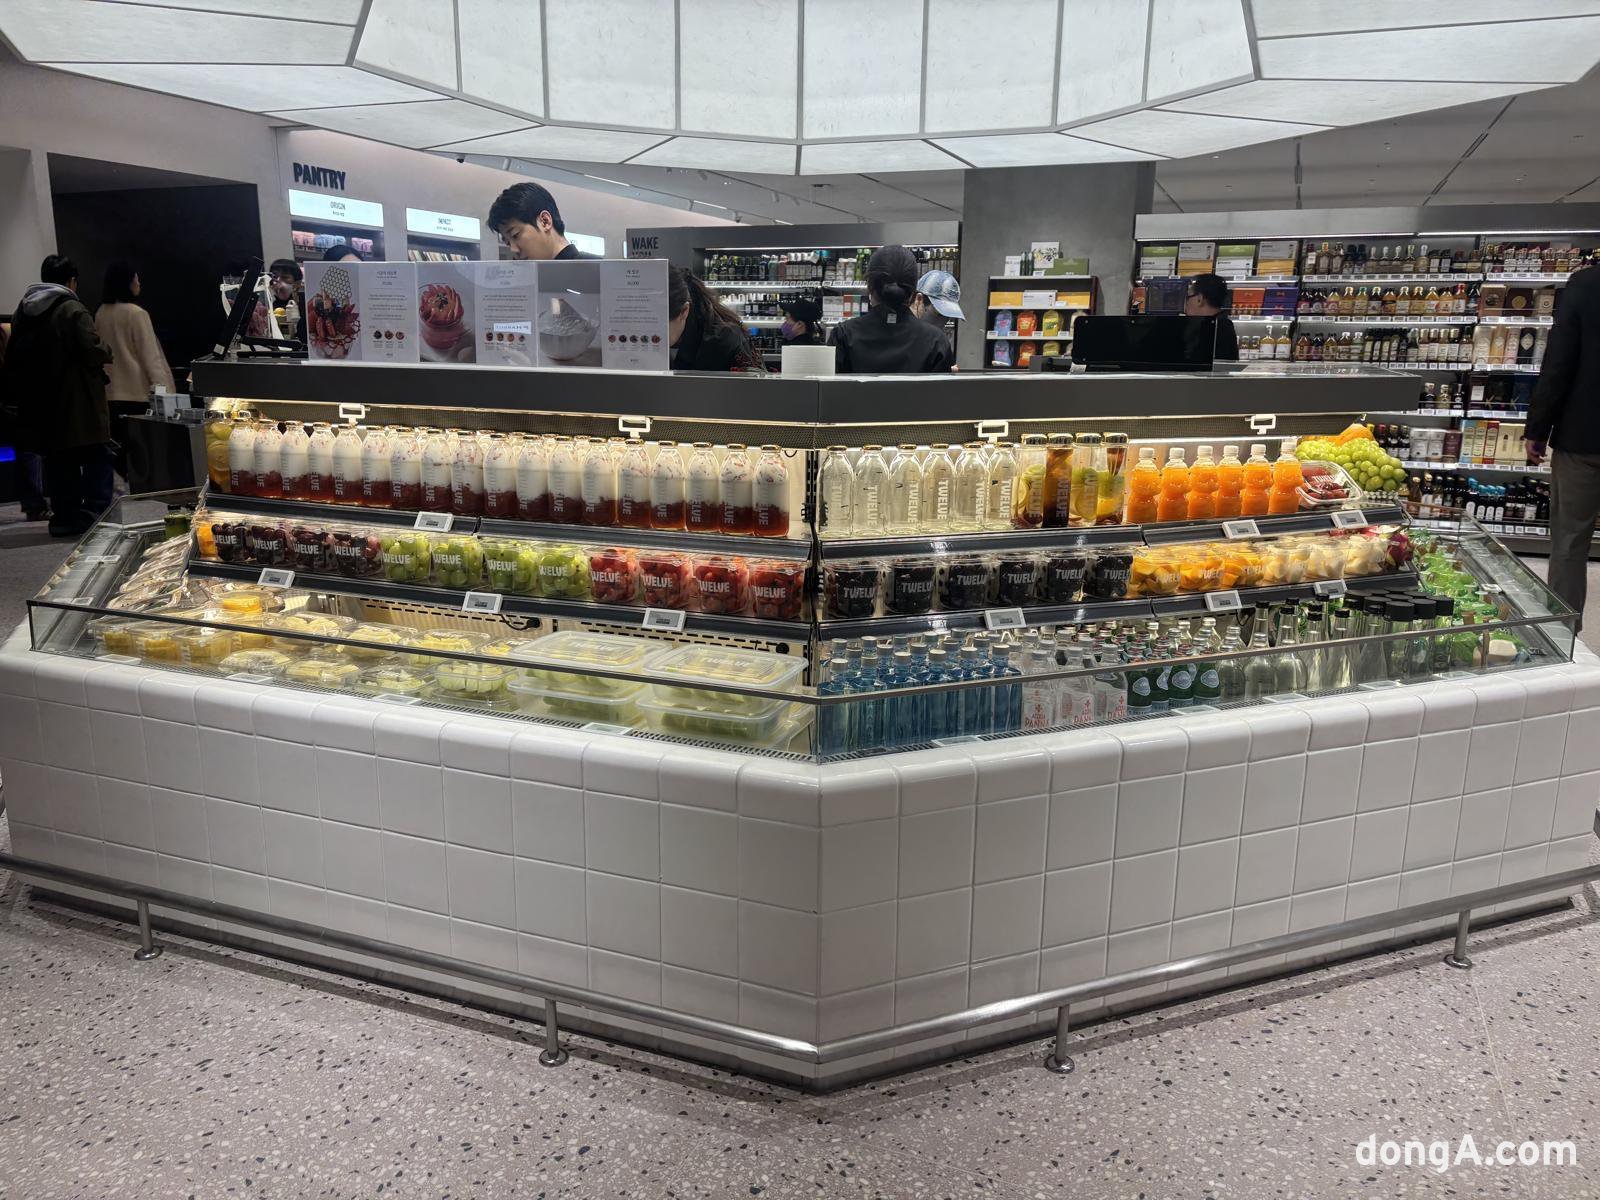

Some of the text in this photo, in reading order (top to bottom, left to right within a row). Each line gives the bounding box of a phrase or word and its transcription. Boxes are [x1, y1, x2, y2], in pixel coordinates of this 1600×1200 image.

[293, 162, 346, 190] PANTRY
[631, 236, 660, 250] WAKE
[333, 545, 361, 557] WELVE
[486, 559, 518, 571] WELVE
[540, 564, 568, 577] WELVE
[591, 570, 620, 583] WELVE
[1007, 572, 1036, 585] TWELV
[1055, 567, 1085, 580] TWELV
[901, 580, 933, 593] TWELV
